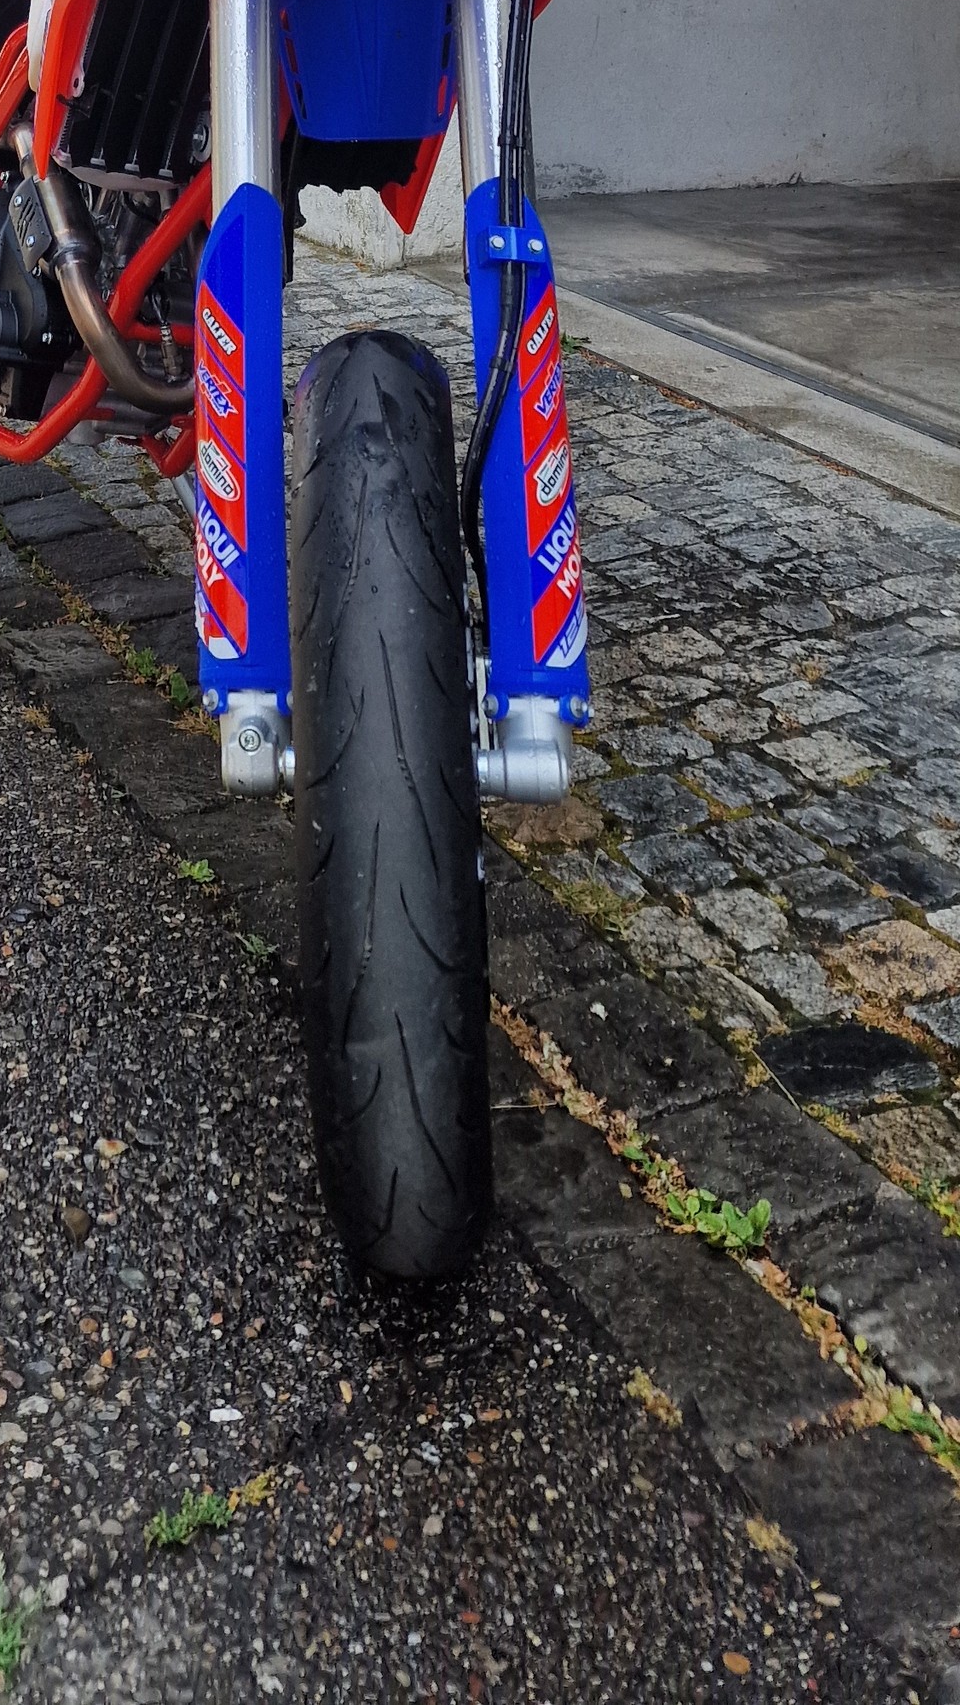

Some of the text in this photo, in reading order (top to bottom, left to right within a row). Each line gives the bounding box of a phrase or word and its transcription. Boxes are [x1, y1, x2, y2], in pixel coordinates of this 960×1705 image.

[202, 308, 237, 355] GALFER
[199, 361, 234, 413] VERTEX
[200, 441, 234, 496] domino
[537, 445, 568, 496] domino
[198, 499, 240, 569] LIQUI
[537, 504, 577, 575] LIQUI
